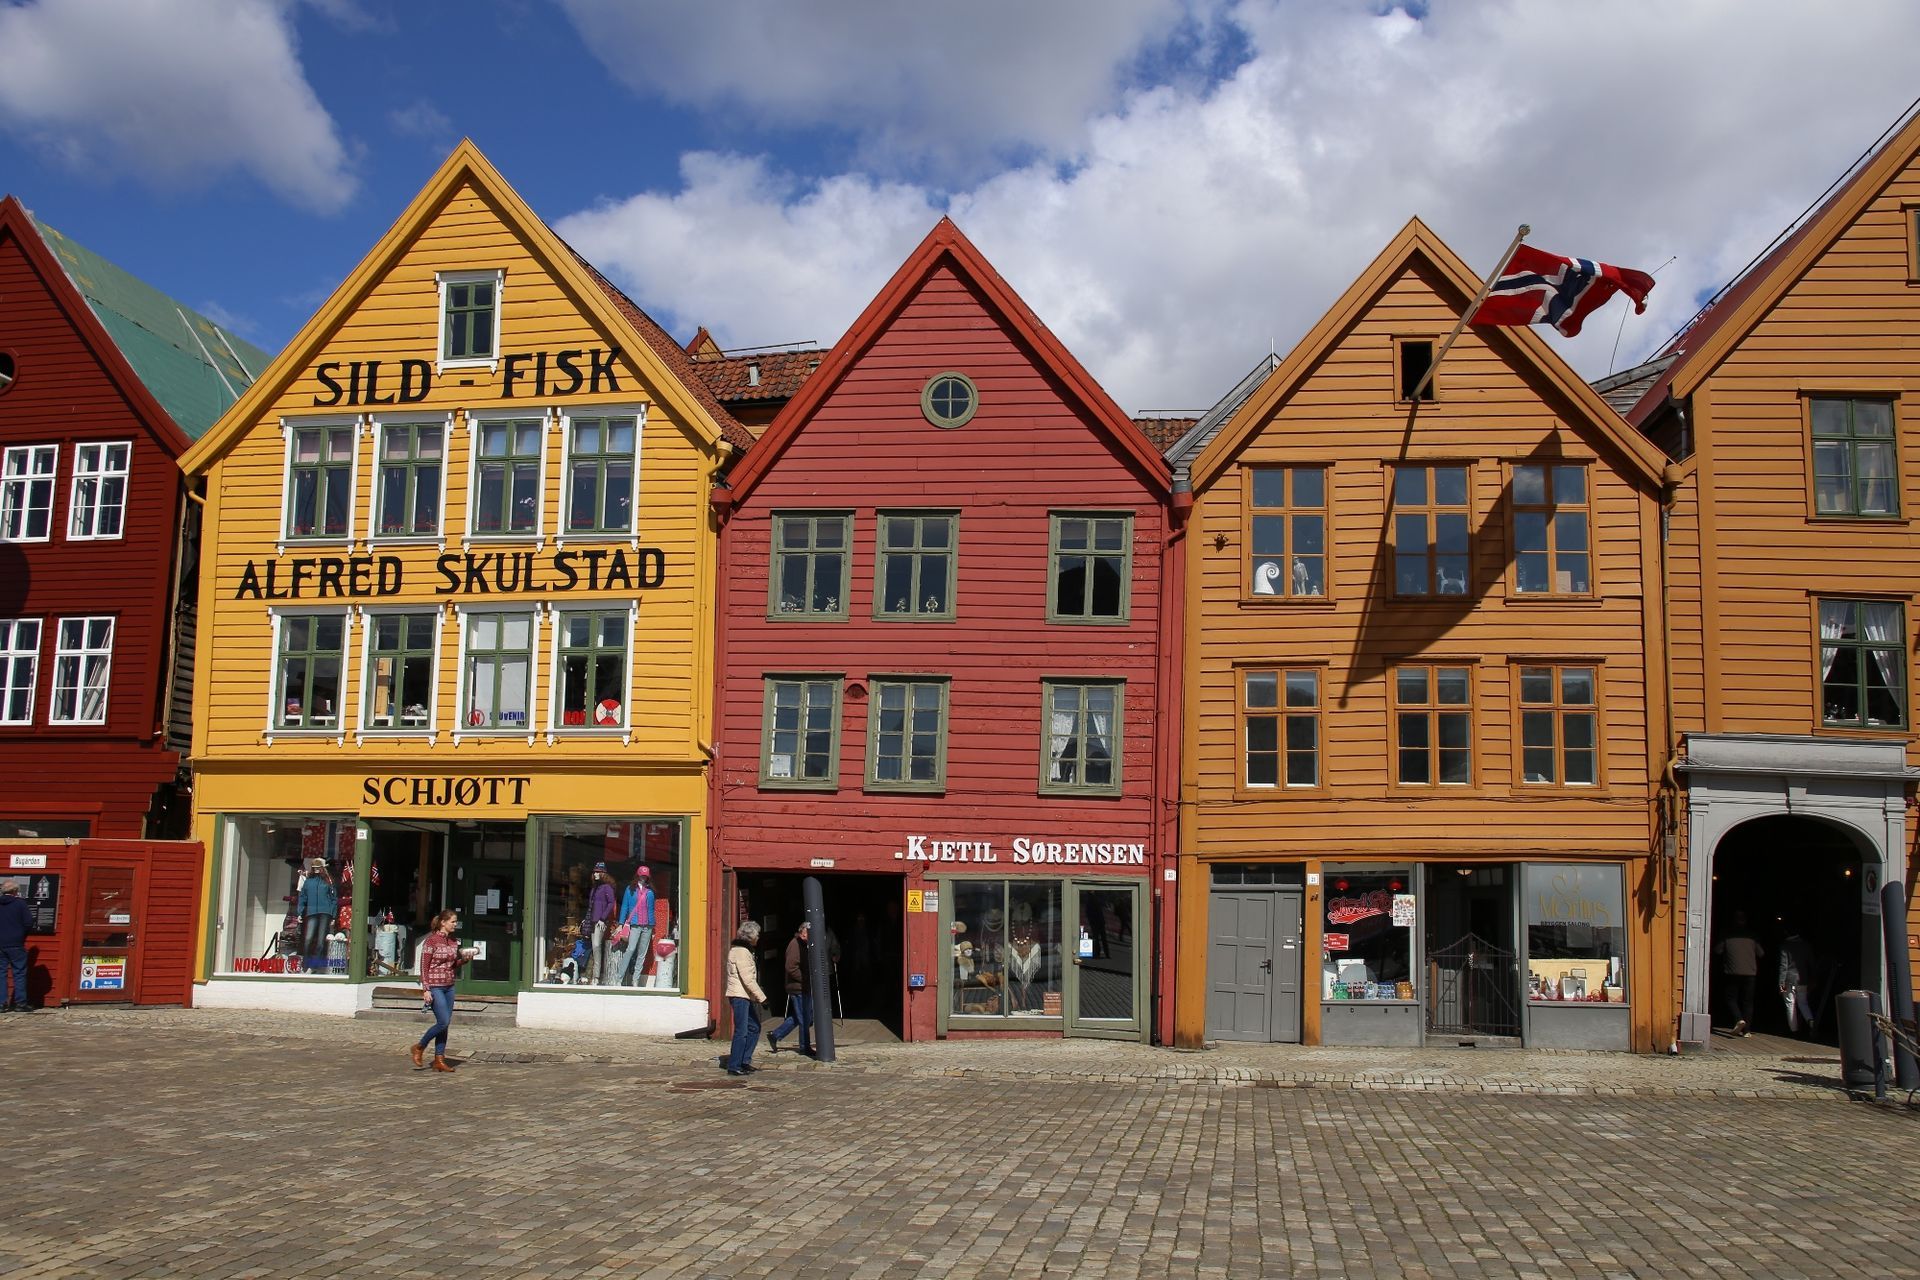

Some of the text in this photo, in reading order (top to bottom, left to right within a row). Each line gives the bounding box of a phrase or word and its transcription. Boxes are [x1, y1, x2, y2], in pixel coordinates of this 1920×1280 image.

[313, 359, 431, 407] SILD
[500, 347, 622, 399] FISK
[235, 547, 666, 600] ALFRED SKULSTAD
[362, 776, 531, 807] SCHJØTT
[906, 835, 1145, 864] KJETIL SØRENSEN
